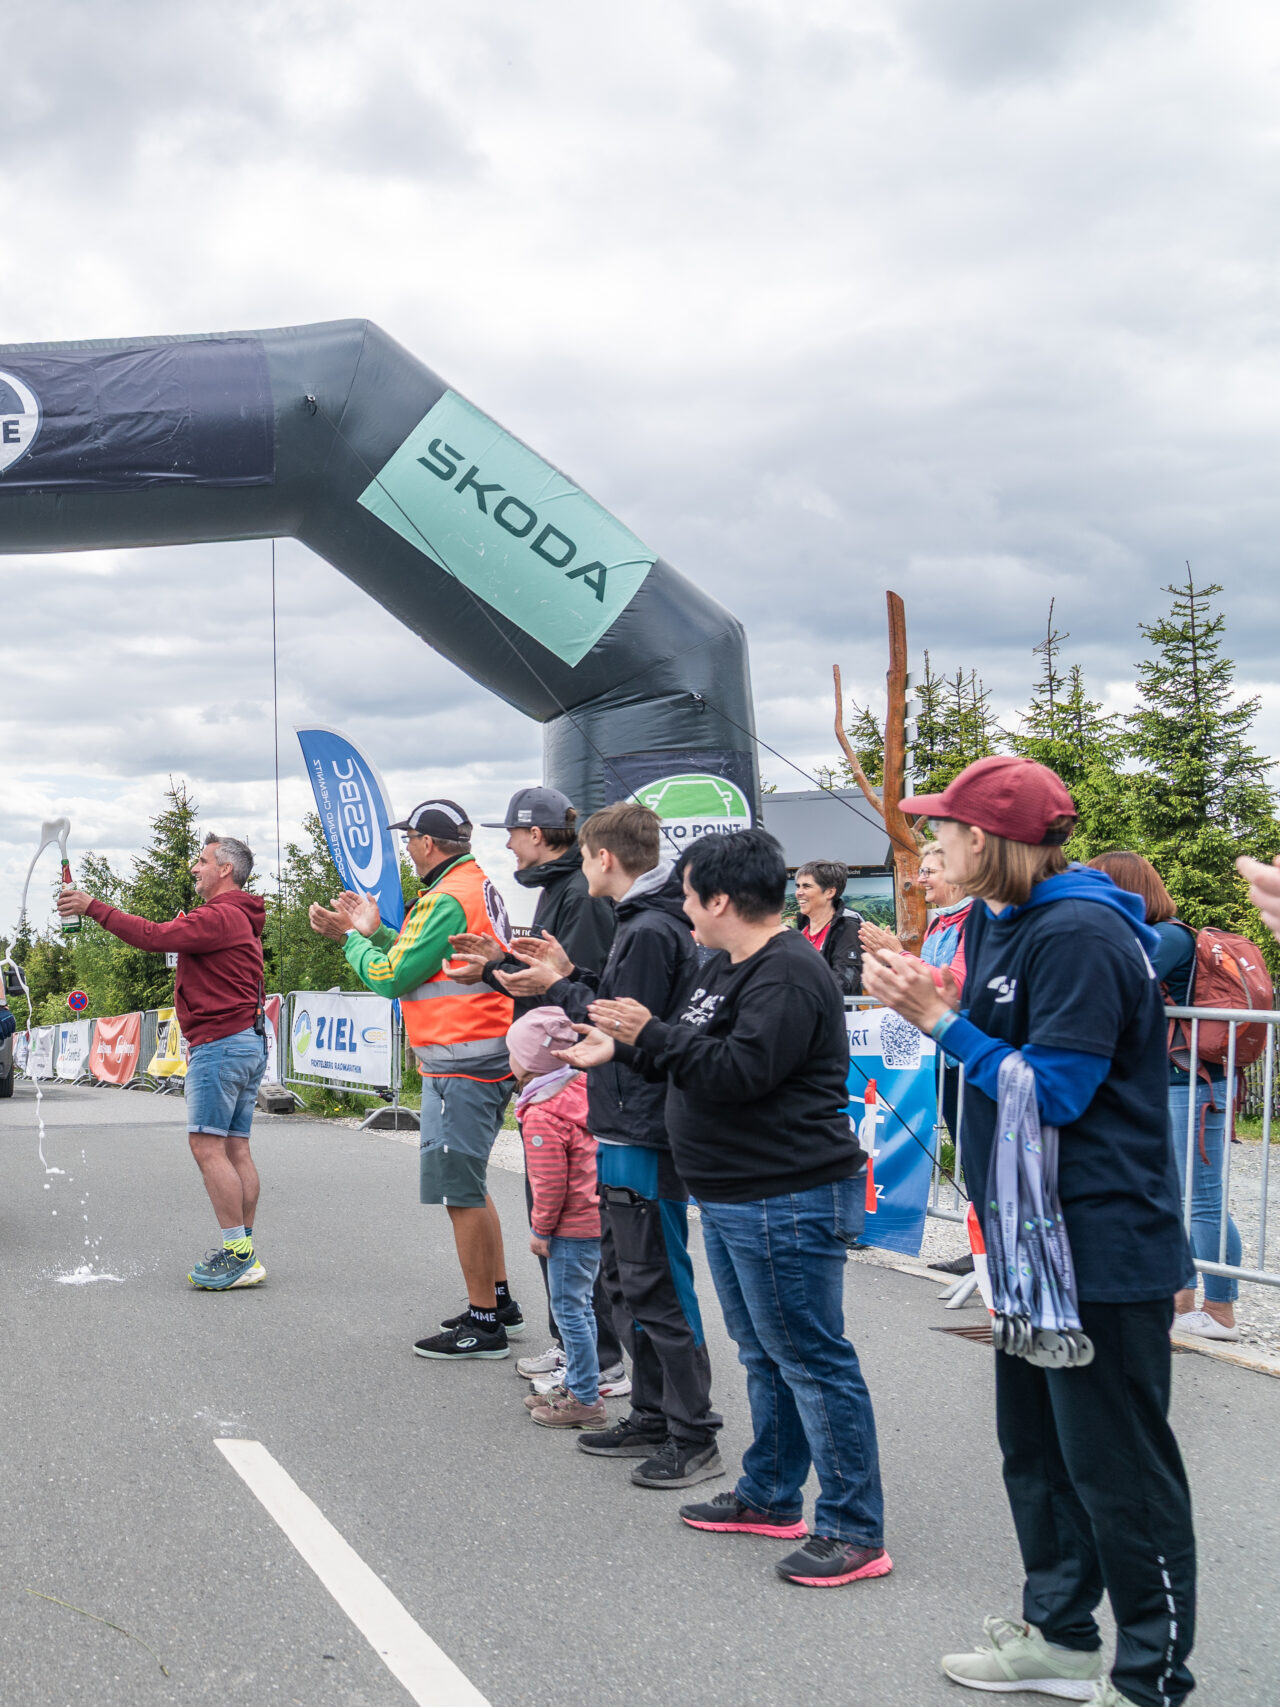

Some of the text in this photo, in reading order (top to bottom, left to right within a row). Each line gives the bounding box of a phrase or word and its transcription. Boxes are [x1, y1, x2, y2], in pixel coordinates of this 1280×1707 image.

[416, 438, 608, 603] SKODA
[662, 825, 687, 839] TO
[315, 1016, 358, 1053] ZIEL
[470, 1309, 497, 1322] MME
